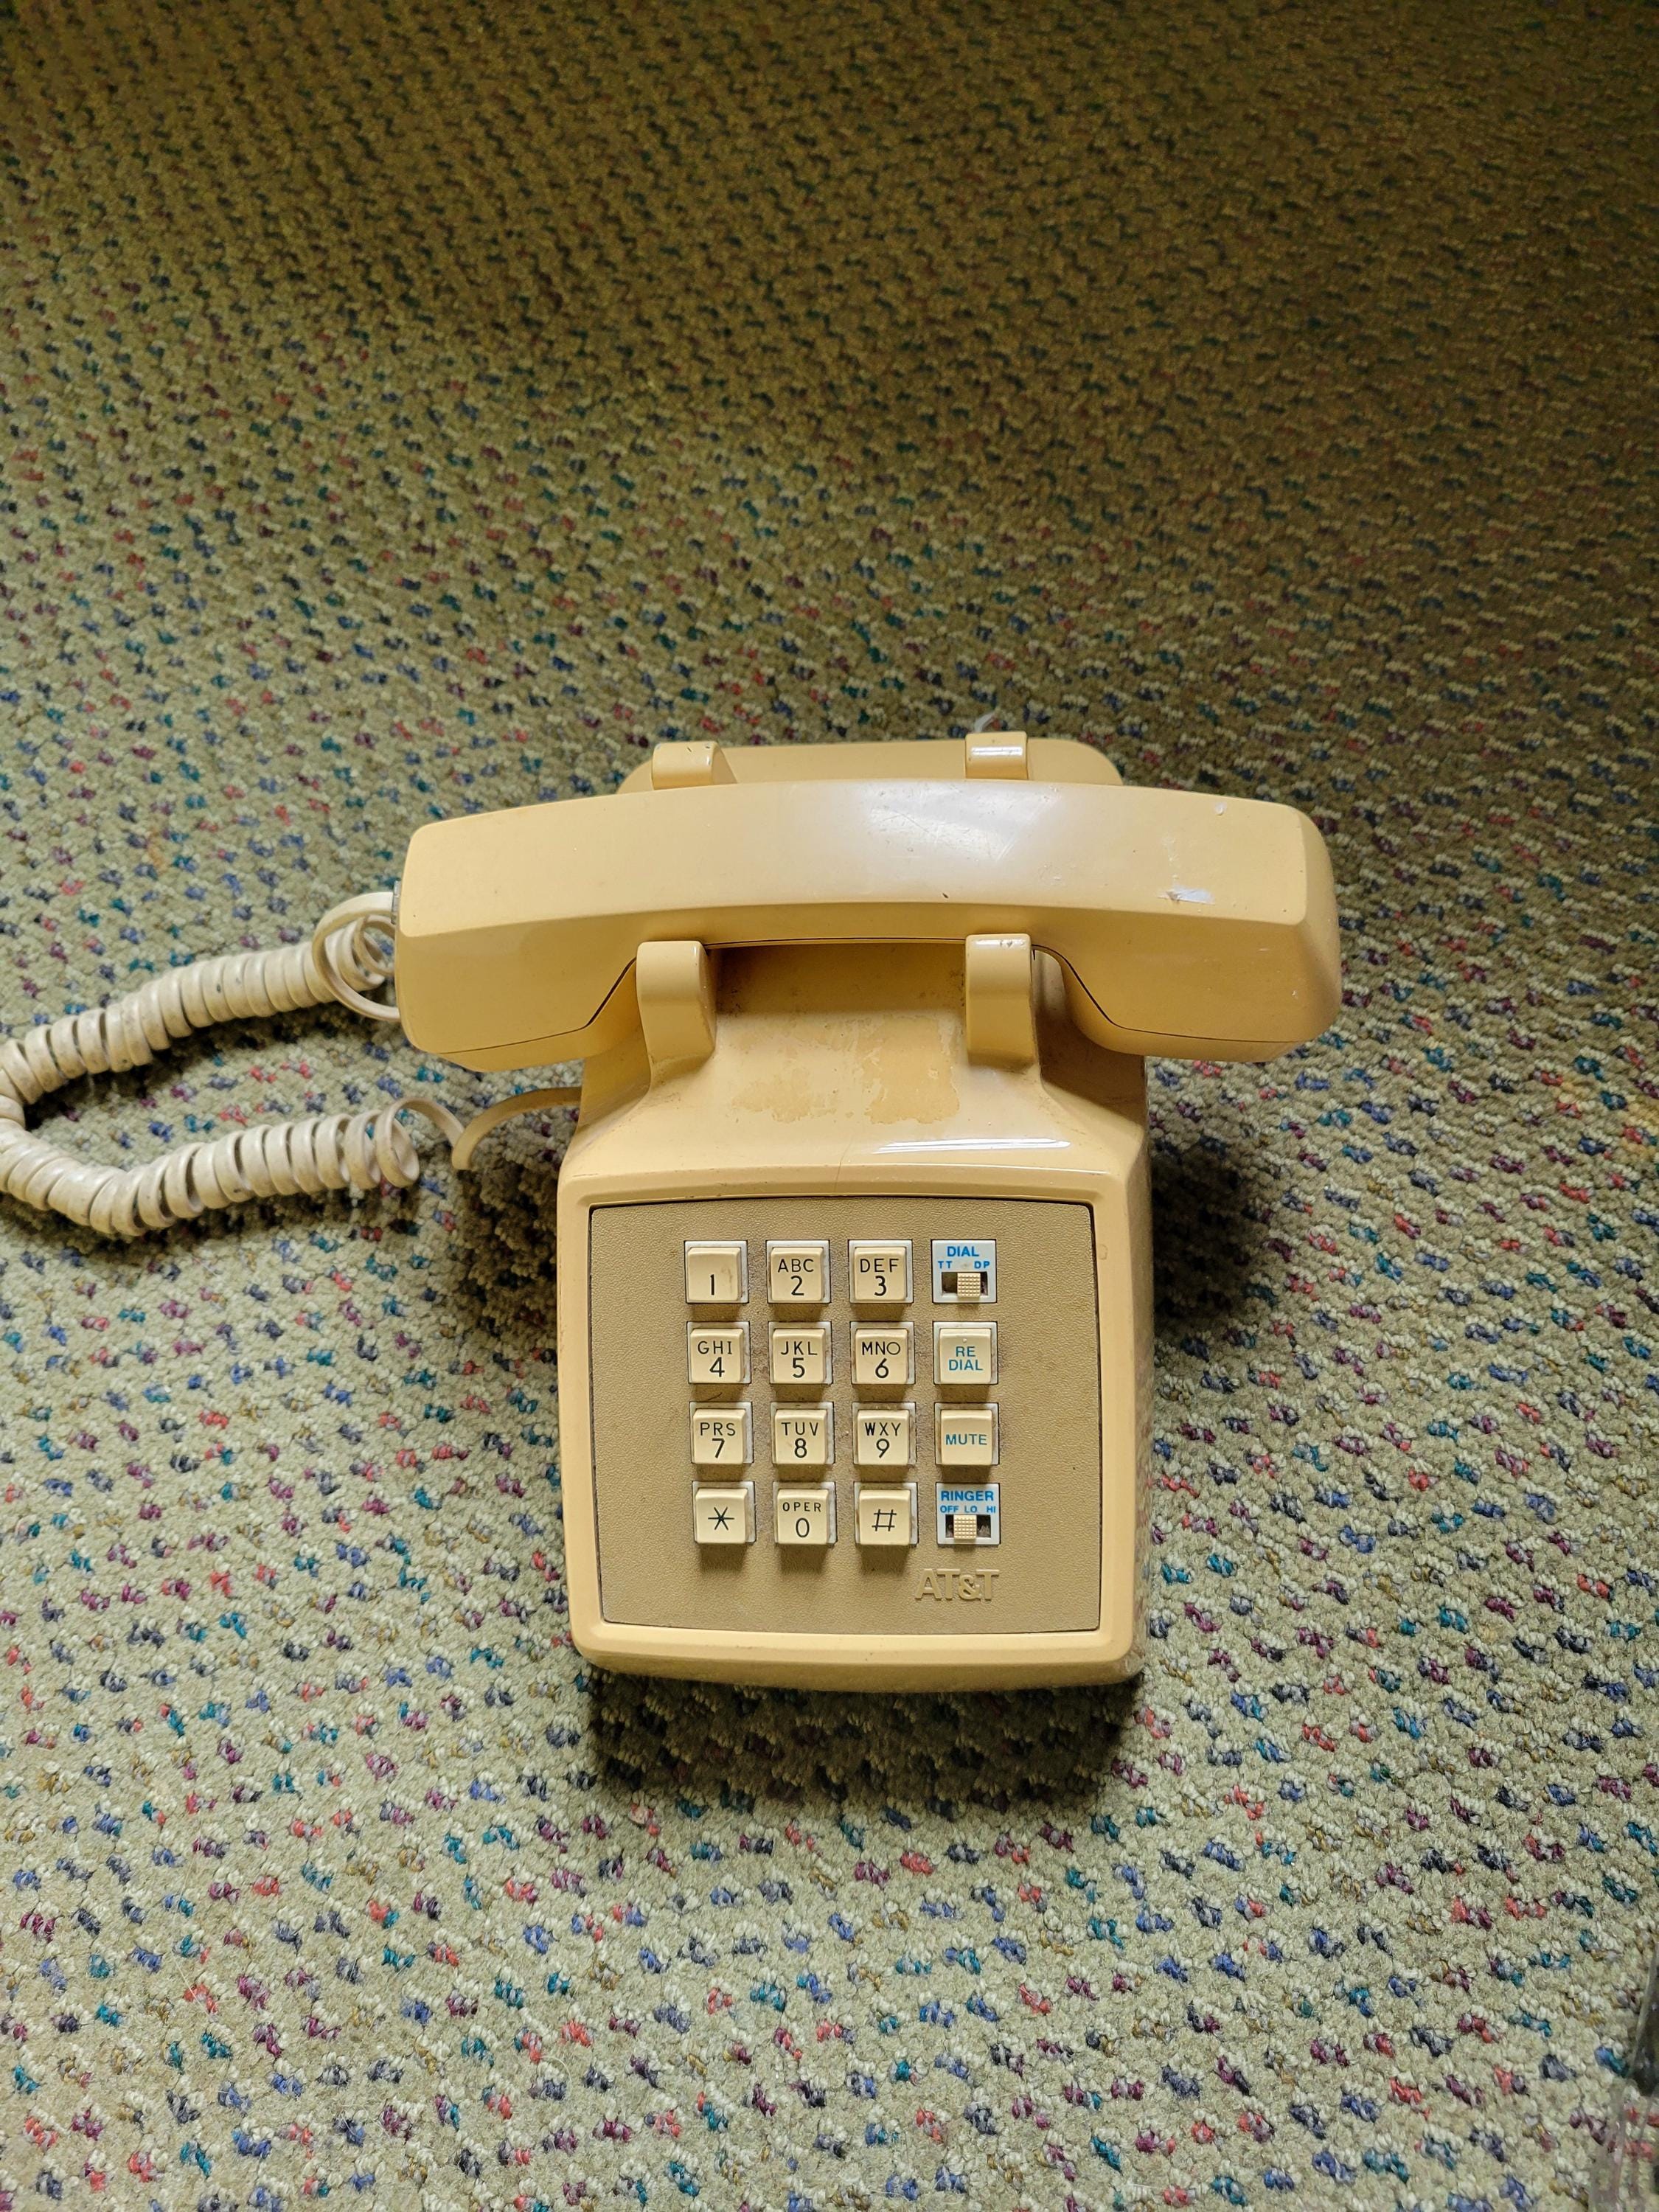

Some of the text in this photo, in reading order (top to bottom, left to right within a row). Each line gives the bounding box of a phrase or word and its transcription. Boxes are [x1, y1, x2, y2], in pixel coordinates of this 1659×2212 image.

[947, 1246, 980, 1257] DIAL
[777, 1259, 814, 1273] ABC
[860, 1259, 899, 1273] DEF
[937, 1261, 990, 1269] TT DP
[709, 1274, 715, 1295] 1
[790, 1276, 804, 1295] 2
[874, 1276, 887, 1296] 3
[697, 1340, 732, 1354] GHI
[780, 1341, 818, 1355] JKL
[861, 1341, 901, 1355] MNO
[956, 1346, 976, 1357] RE
[709, 1357, 725, 1377] 4
[792, 1357, 805, 1378] 5
[874, 1358, 889, 1379] 6
[948, 1360, 984, 1371] DIAL
[700, 1422, 736, 1436] PRS
[781, 1422, 818, 1436] TUV
[864, 1422, 901, 1436] WXY
[945, 1433, 987, 1445] MUTE
[712, 1438, 725, 1458] 7
[794, 1438, 807, 1458] 8
[876, 1438, 890, 1458] 9
[940, 1490, 994, 1501] RINGER
[782, 1502, 821, 1512] OPER
[939, 1505, 959, 1513] OFF
[987, 1506, 995, 1514] HI
[796, 1517, 810, 1538] 0
[872, 1509, 897, 1532] #
[914, 1568, 1000, 1601] AT&T
